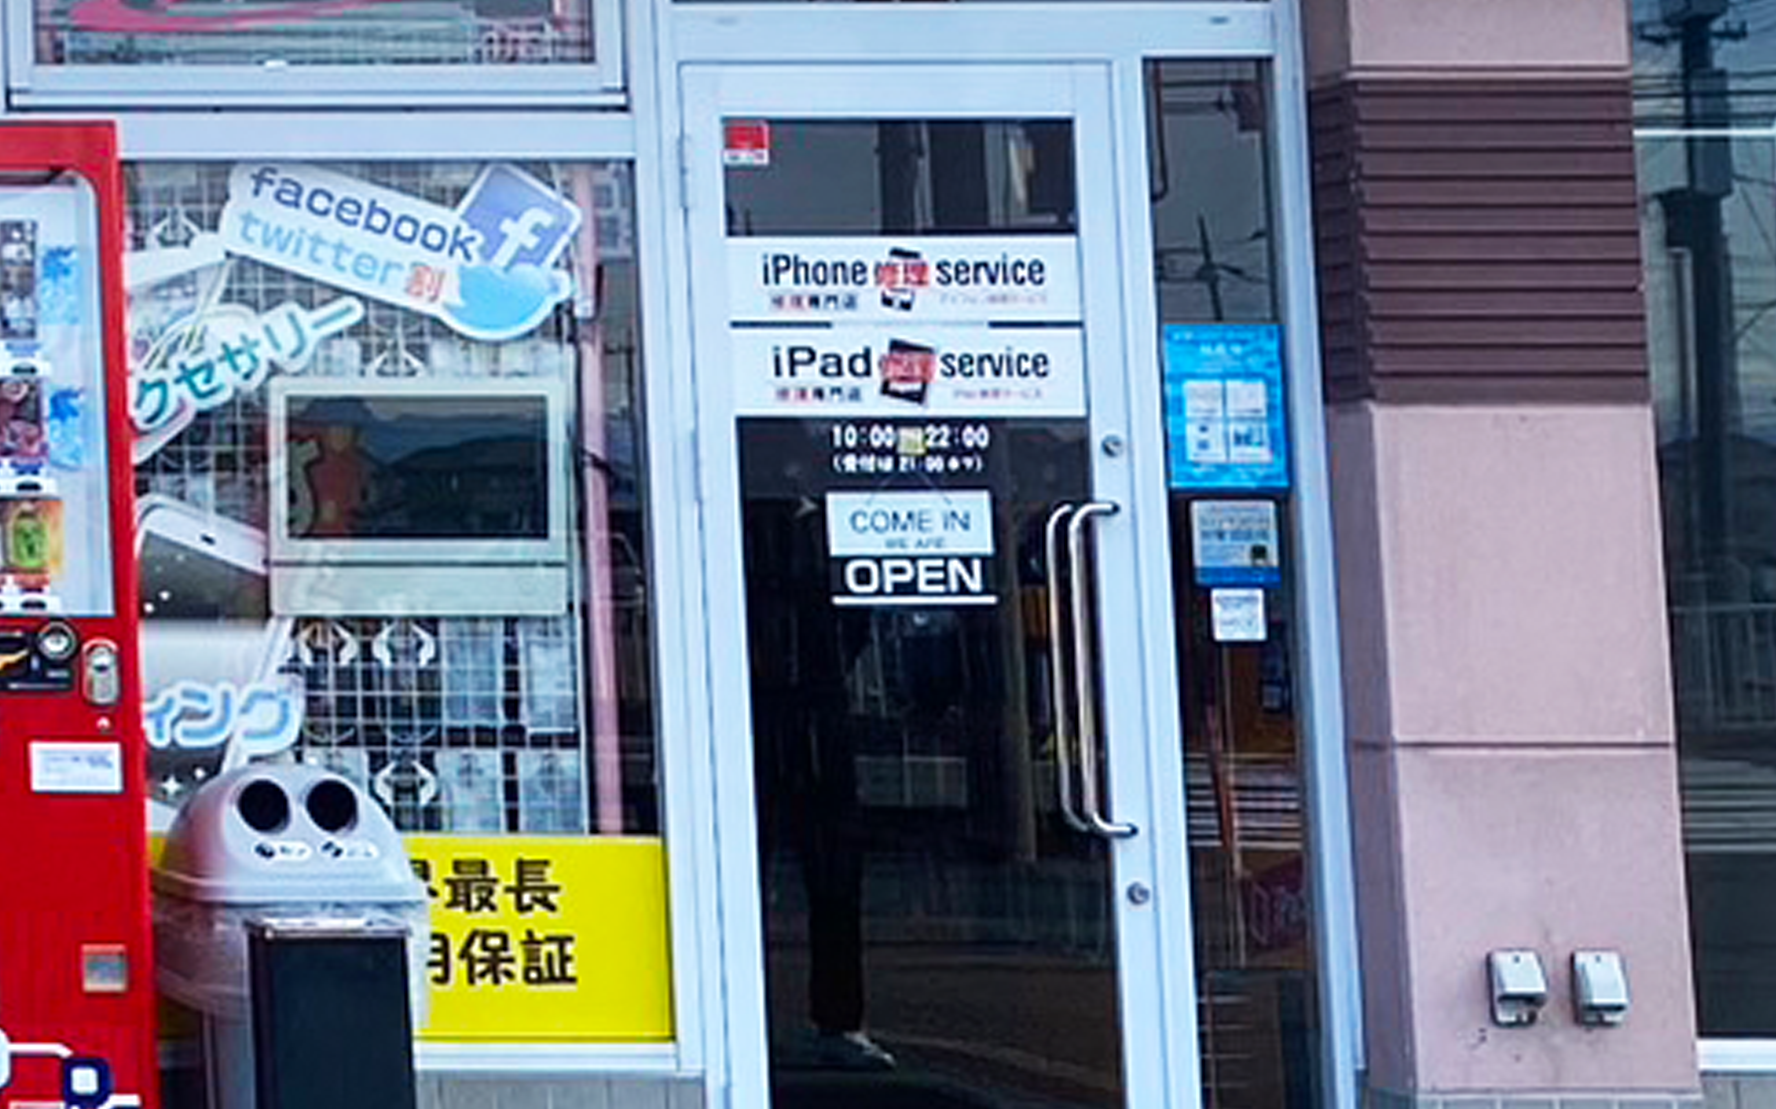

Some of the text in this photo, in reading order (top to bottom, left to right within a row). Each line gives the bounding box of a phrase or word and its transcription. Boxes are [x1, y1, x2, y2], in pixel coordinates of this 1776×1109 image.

[251, 166, 476, 262] facebook
[762, 254, 867, 286] iPhone
[936, 252, 1045, 286] service
[773, 346, 872, 377] iPad
[940, 346, 1049, 377] service
[832, 424, 990, 448] 10:0022:00
[850, 509, 971, 533] COME IN
[846, 558, 983, 593] OPEN
